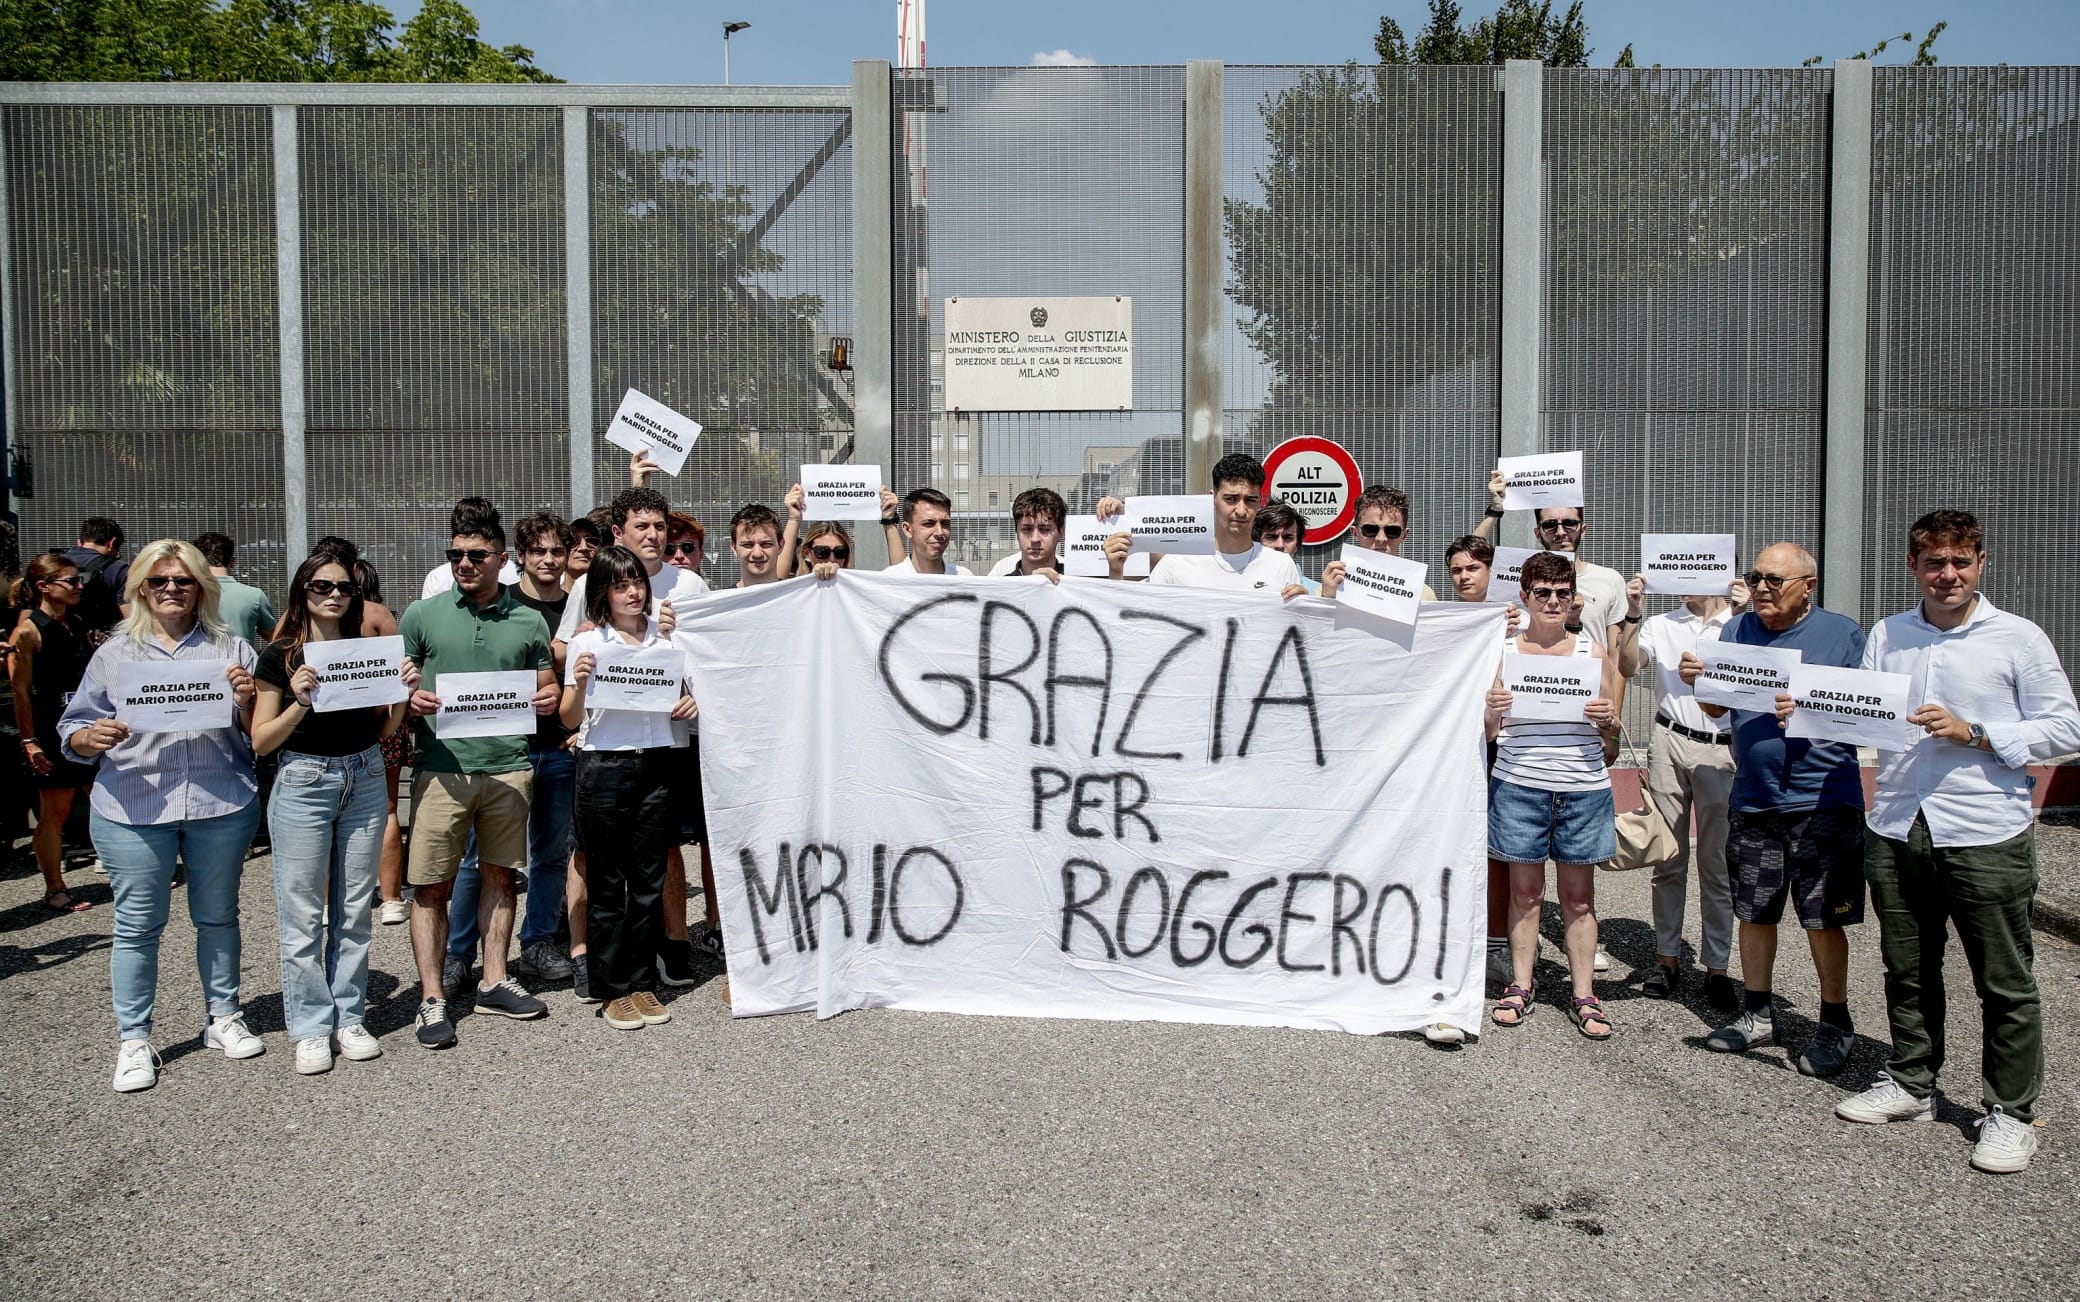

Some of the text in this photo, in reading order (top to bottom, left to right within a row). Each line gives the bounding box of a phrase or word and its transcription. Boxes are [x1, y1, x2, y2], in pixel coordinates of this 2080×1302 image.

[950, 331, 1128, 343] MINISTERO DELLA GIUSTIZIA
[948, 346, 996, 354] DIPARTIMENTO
[955, 358, 997, 366] DIREZIONE
[1000, 358, 1026, 366] DELLA
[1039, 357, 1060, 365] CASA
[1063, 357, 1071, 365] DI
[1074, 357, 1123, 365] RECLUSIONE
[1018, 368, 1059, 378] MILANO
[634, 412, 678, 440] GRAZIA PER
[620, 415, 646, 432] MARIO
[646, 429, 683, 453] ROGGERO
[1298, 467, 1322, 479] ALT
[1514, 470, 1546, 478] GRAZIA
[1533, 478, 1575, 486] ROGGERO
[1282, 492, 1337, 504] POLIZIA
[1142, 516, 1175, 524] GRAZIA
[1162, 526, 1207, 534] ROGGERO
[1356, 567, 1405, 586] GRAZIA PER
[1496, 574, 1520, 582] MARI
[1344, 573, 1370, 587] MARIO
[1371, 582, 1414, 598] ROGGERO
[328, 659, 386, 671] GRAZIA PER
[608, 666, 644, 675] GRAZIA
[1717, 663, 1778, 677] GRAZIA PER
[316, 669, 399, 684] MARIO ROGGERO
[595, 675, 674, 686] MARIO ROGGERO
[878, 593, 1326, 766] GRAZIA
[1524, 675, 1559, 684] GRAZIA
[1704, 671, 1789, 689] MARIO ROGGERO
[142, 683, 210, 693] GRAZIA PER
[1511, 684, 1591, 696] MARIO ROGGERO
[126, 693, 224, 705] MARIO ROGGERO
[457, 693, 495, 702] GRAZIA
[1810, 690, 1882, 706] GRAZIA PER
[445, 702, 528, 713] MARIO ROGGERO
[1795, 700, 1896, 720] MARIO ROGGERO
[1031, 766, 1158, 843] PER
[1061, 857, 1452, 1001] ROGGERO!
